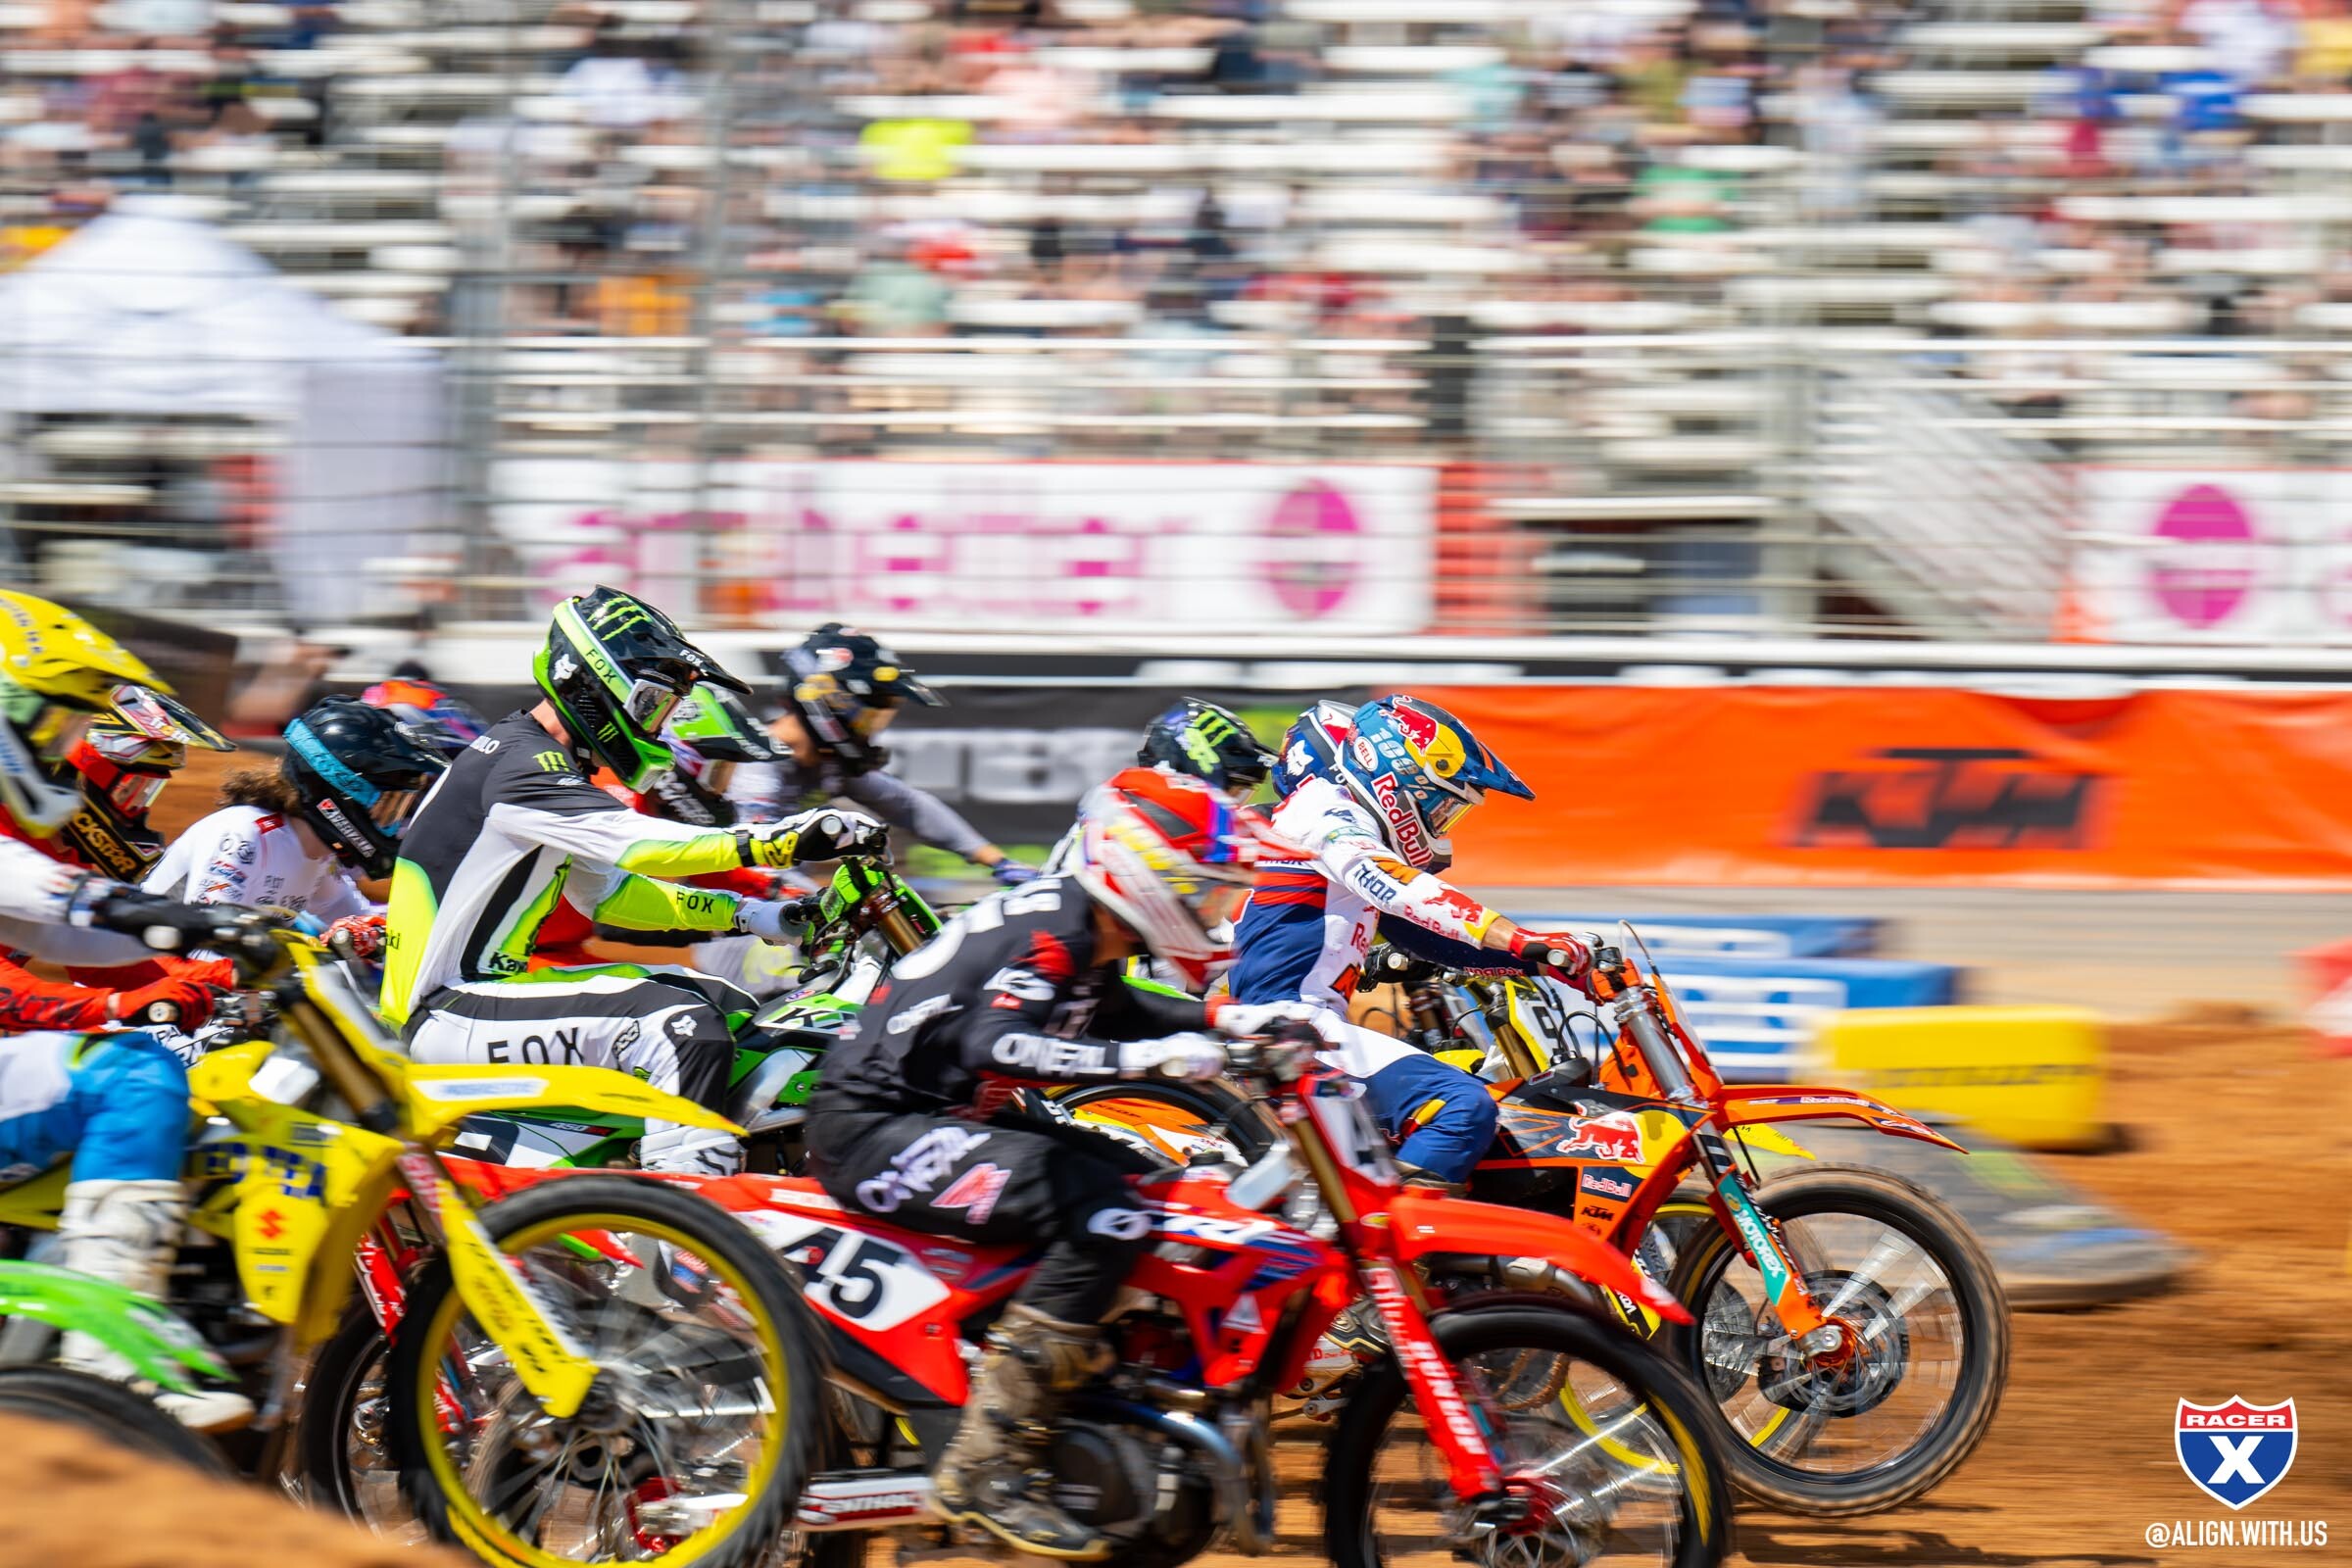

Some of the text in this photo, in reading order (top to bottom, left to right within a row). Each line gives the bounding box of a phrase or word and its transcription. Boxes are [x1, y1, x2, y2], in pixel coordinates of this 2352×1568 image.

[586, 648, 616, 685] FOX
[680, 648, 705, 668] FOX
[1356, 741, 1373, 767] BELL
[1329, 762, 1348, 785] FO
[1789, 747, 2097, 849] KTM
[74, 811, 137, 875] CKSTAR
[1353, 863, 1397, 904] THOR
[677, 891, 714, 914] FOX
[487, 1027, 585, 1065] FOX
[1581, 1205, 1615, 1222] KTM
[1735, 1208, 1788, 1278] MOTOREX
[1405, 1341, 1489, 1454] DUNLOP
